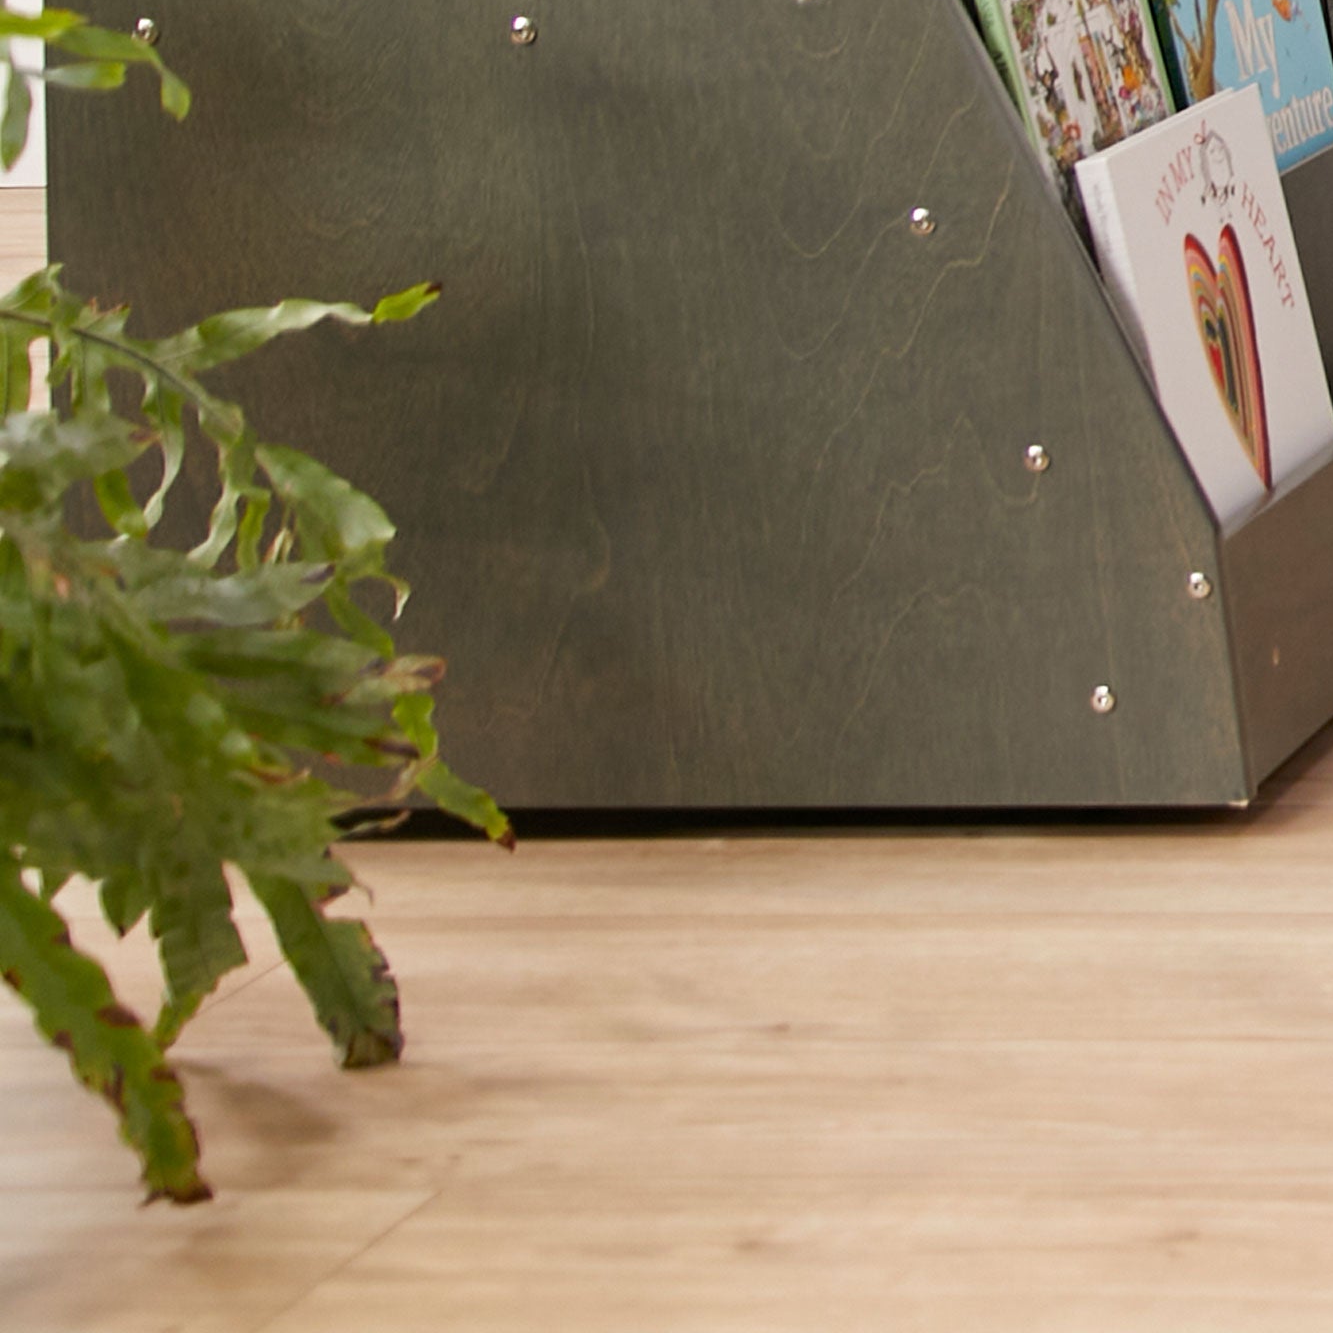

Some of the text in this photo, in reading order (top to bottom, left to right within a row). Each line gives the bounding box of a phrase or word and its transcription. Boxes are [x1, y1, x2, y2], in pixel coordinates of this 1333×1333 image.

[1155, 175, 1175, 227] IN
[1168, 146, 1195, 194] MY
[1241, 182, 1296, 309] HEART
